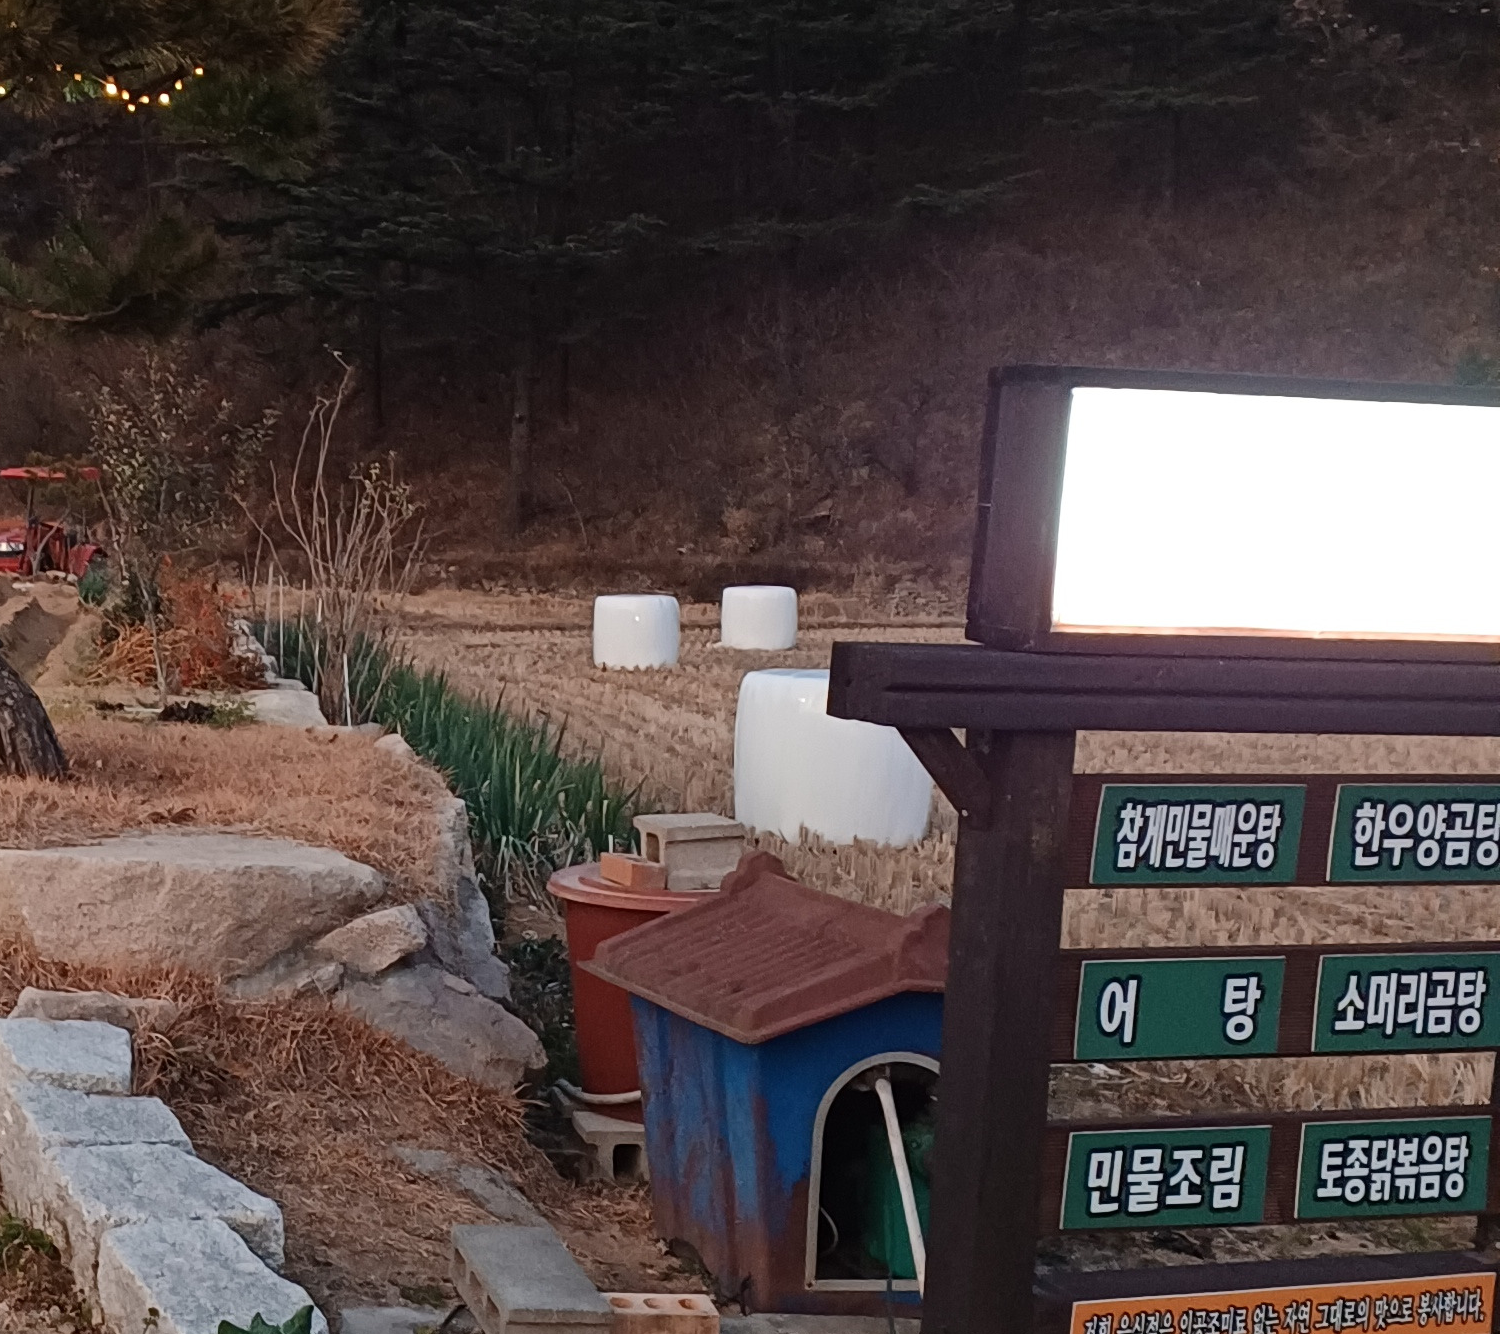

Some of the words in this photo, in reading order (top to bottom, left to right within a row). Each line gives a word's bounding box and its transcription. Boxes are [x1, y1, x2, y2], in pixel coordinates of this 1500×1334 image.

[1117, 803, 1281, 868] 참게민물매운탕
[1355, 802, 1500, 866] 한우양곰탕
[1334, 971, 1486, 1035] 소머리곰탕
[1087, 1145, 1245, 1213] 민물조림
[1317, 1136, 1469, 1202] 토종닭볶음탕
[1284, 1301, 1311, 1334] 자연
[1315, 1297, 1370, 1331] 그대로의
[1375, 1295, 1414, 1329] 맛으로
[1417, 1288, 1484, 1326] 봉사합니다.
